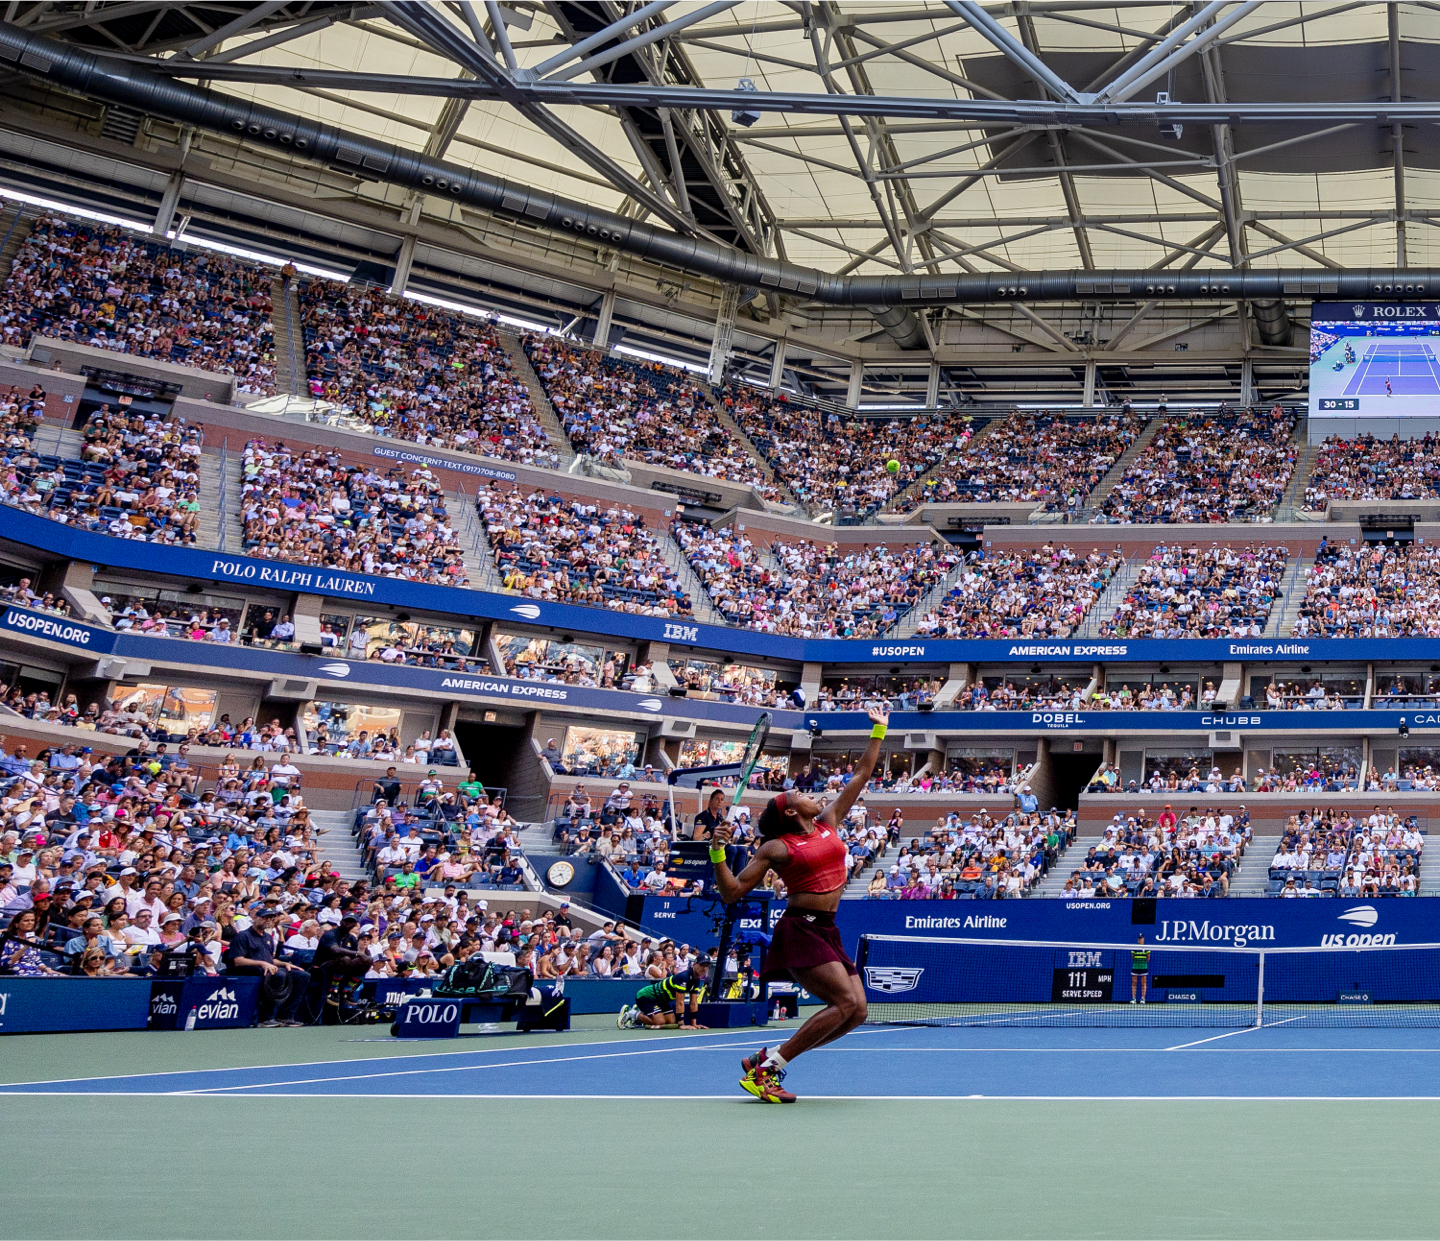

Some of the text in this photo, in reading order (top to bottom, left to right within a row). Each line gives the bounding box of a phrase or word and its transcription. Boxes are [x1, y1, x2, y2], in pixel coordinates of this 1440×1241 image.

[1373, 307, 1427, 317] ROLEX
[374, 447, 516, 480] GUEST CONCERN? TEXT (917)708-8080
[212, 560, 376, 595] POLO RALPH LAUREN
[6, 610, 91, 645] USOPEN.ORG
[662, 623, 699, 642] IBM
[872, 646, 925, 656] #USOPEN
[1009, 646, 1127, 656] AMERICAN EXPRESS
[1229, 644, 1310, 655] Emirates Airline
[441, 678, 568, 700] AMERICAN EXPRESS
[1201, 716, 1261, 725] CHUBB
[1066, 902, 1111, 910] USOPEN.ORG
[905, 915, 1008, 928] Emirates Airline
[1155, 920, 1276, 948] J.P.Morgan
[1321, 932, 1396, 947] us open
[1068, 952, 1102, 967] IBM
[1068, 972, 1112, 987] 111 MPH
[1062, 990, 1103, 998] SERVE SPEED
[152, 1002, 178, 1014] vian
[198, 1000, 238, 1020] evian
[404, 1004, 458, 1024] POLO
